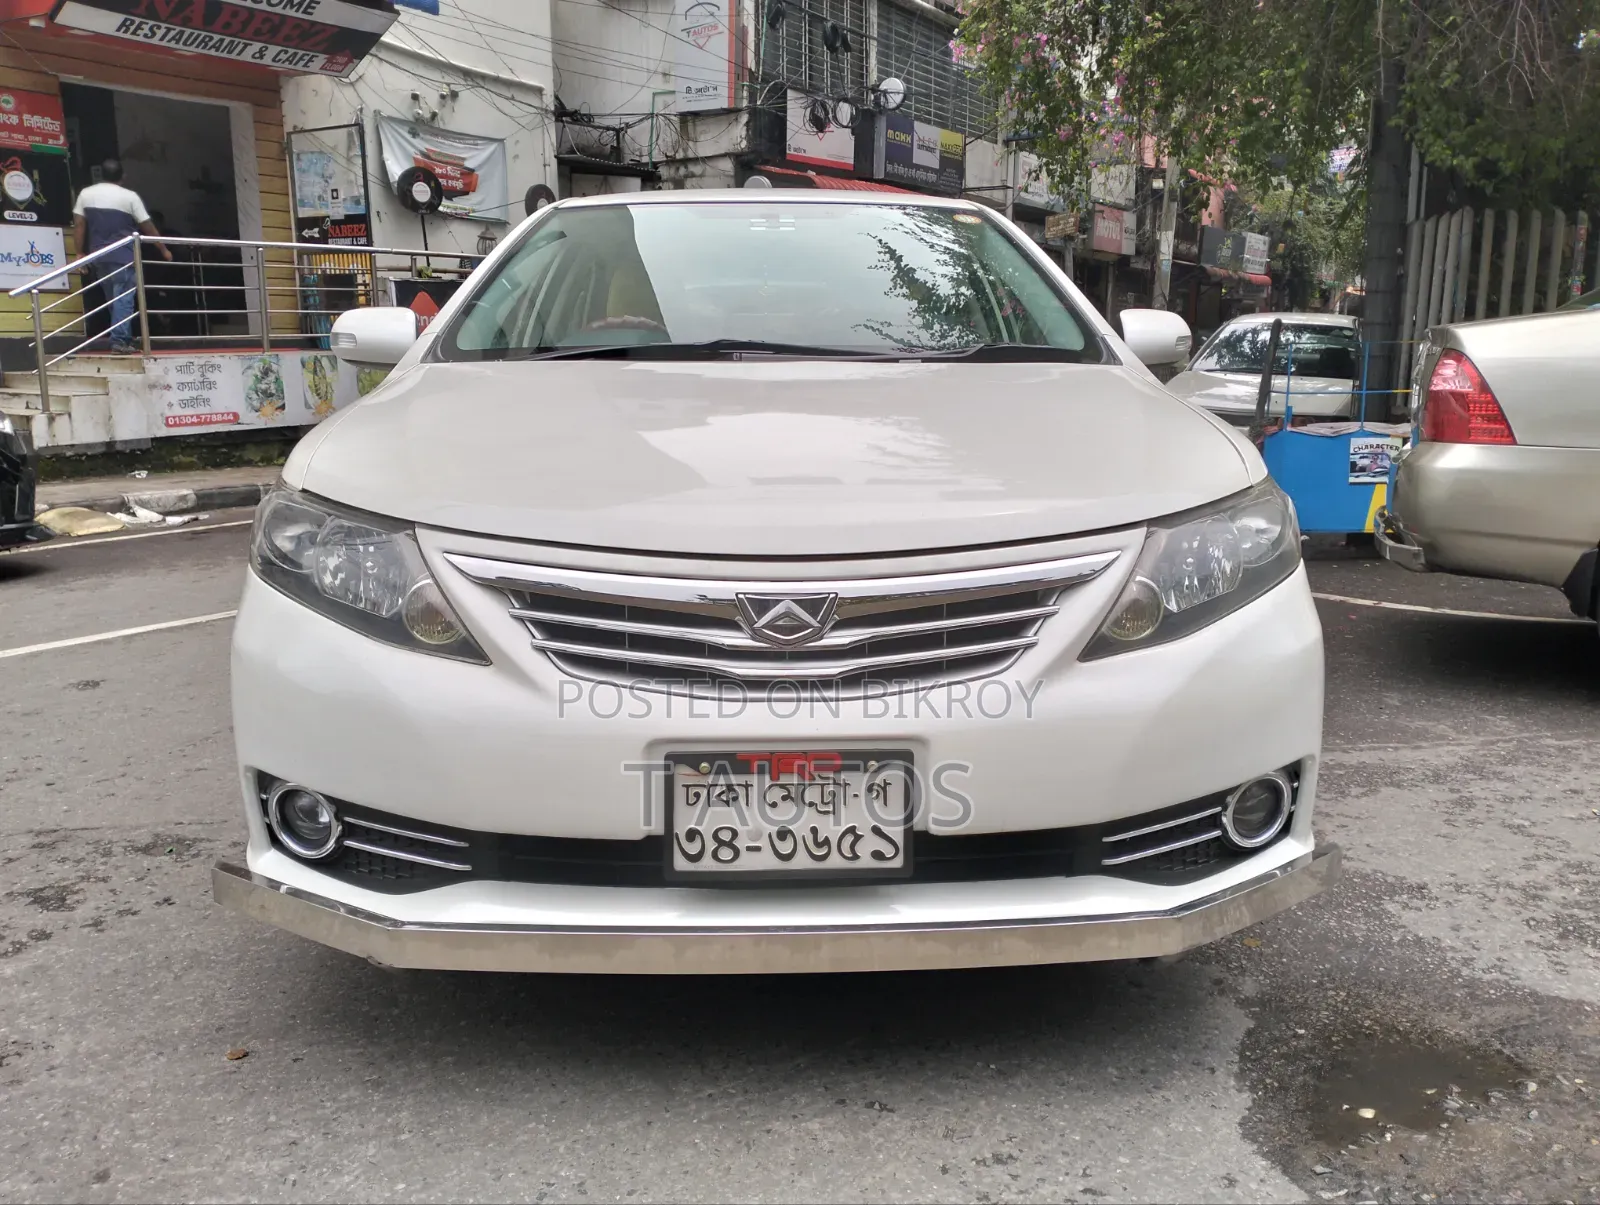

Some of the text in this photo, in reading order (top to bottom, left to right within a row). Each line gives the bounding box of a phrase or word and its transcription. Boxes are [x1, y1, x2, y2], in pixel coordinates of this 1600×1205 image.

[130, 0, 340, 49] NABEEZ
[692, 23, 719, 37] AUTOS
[115, 17, 320, 69] RESTAURANT & CAFE
[22, 114, 61, 132] লিমিটেড
[8, 211, 34, 220] LEVEL-2
[328, 223, 367, 238] NABEEZ
[178, 395, 212, 409] ডাইনিং
[168, 413, 234, 425] 01304-778844
[1353, 443, 1401, 453] CHARACTER
[682, 780, 753, 807] ঢাকা
[675, 825, 900, 863] ৩৪-৩৬৫১
